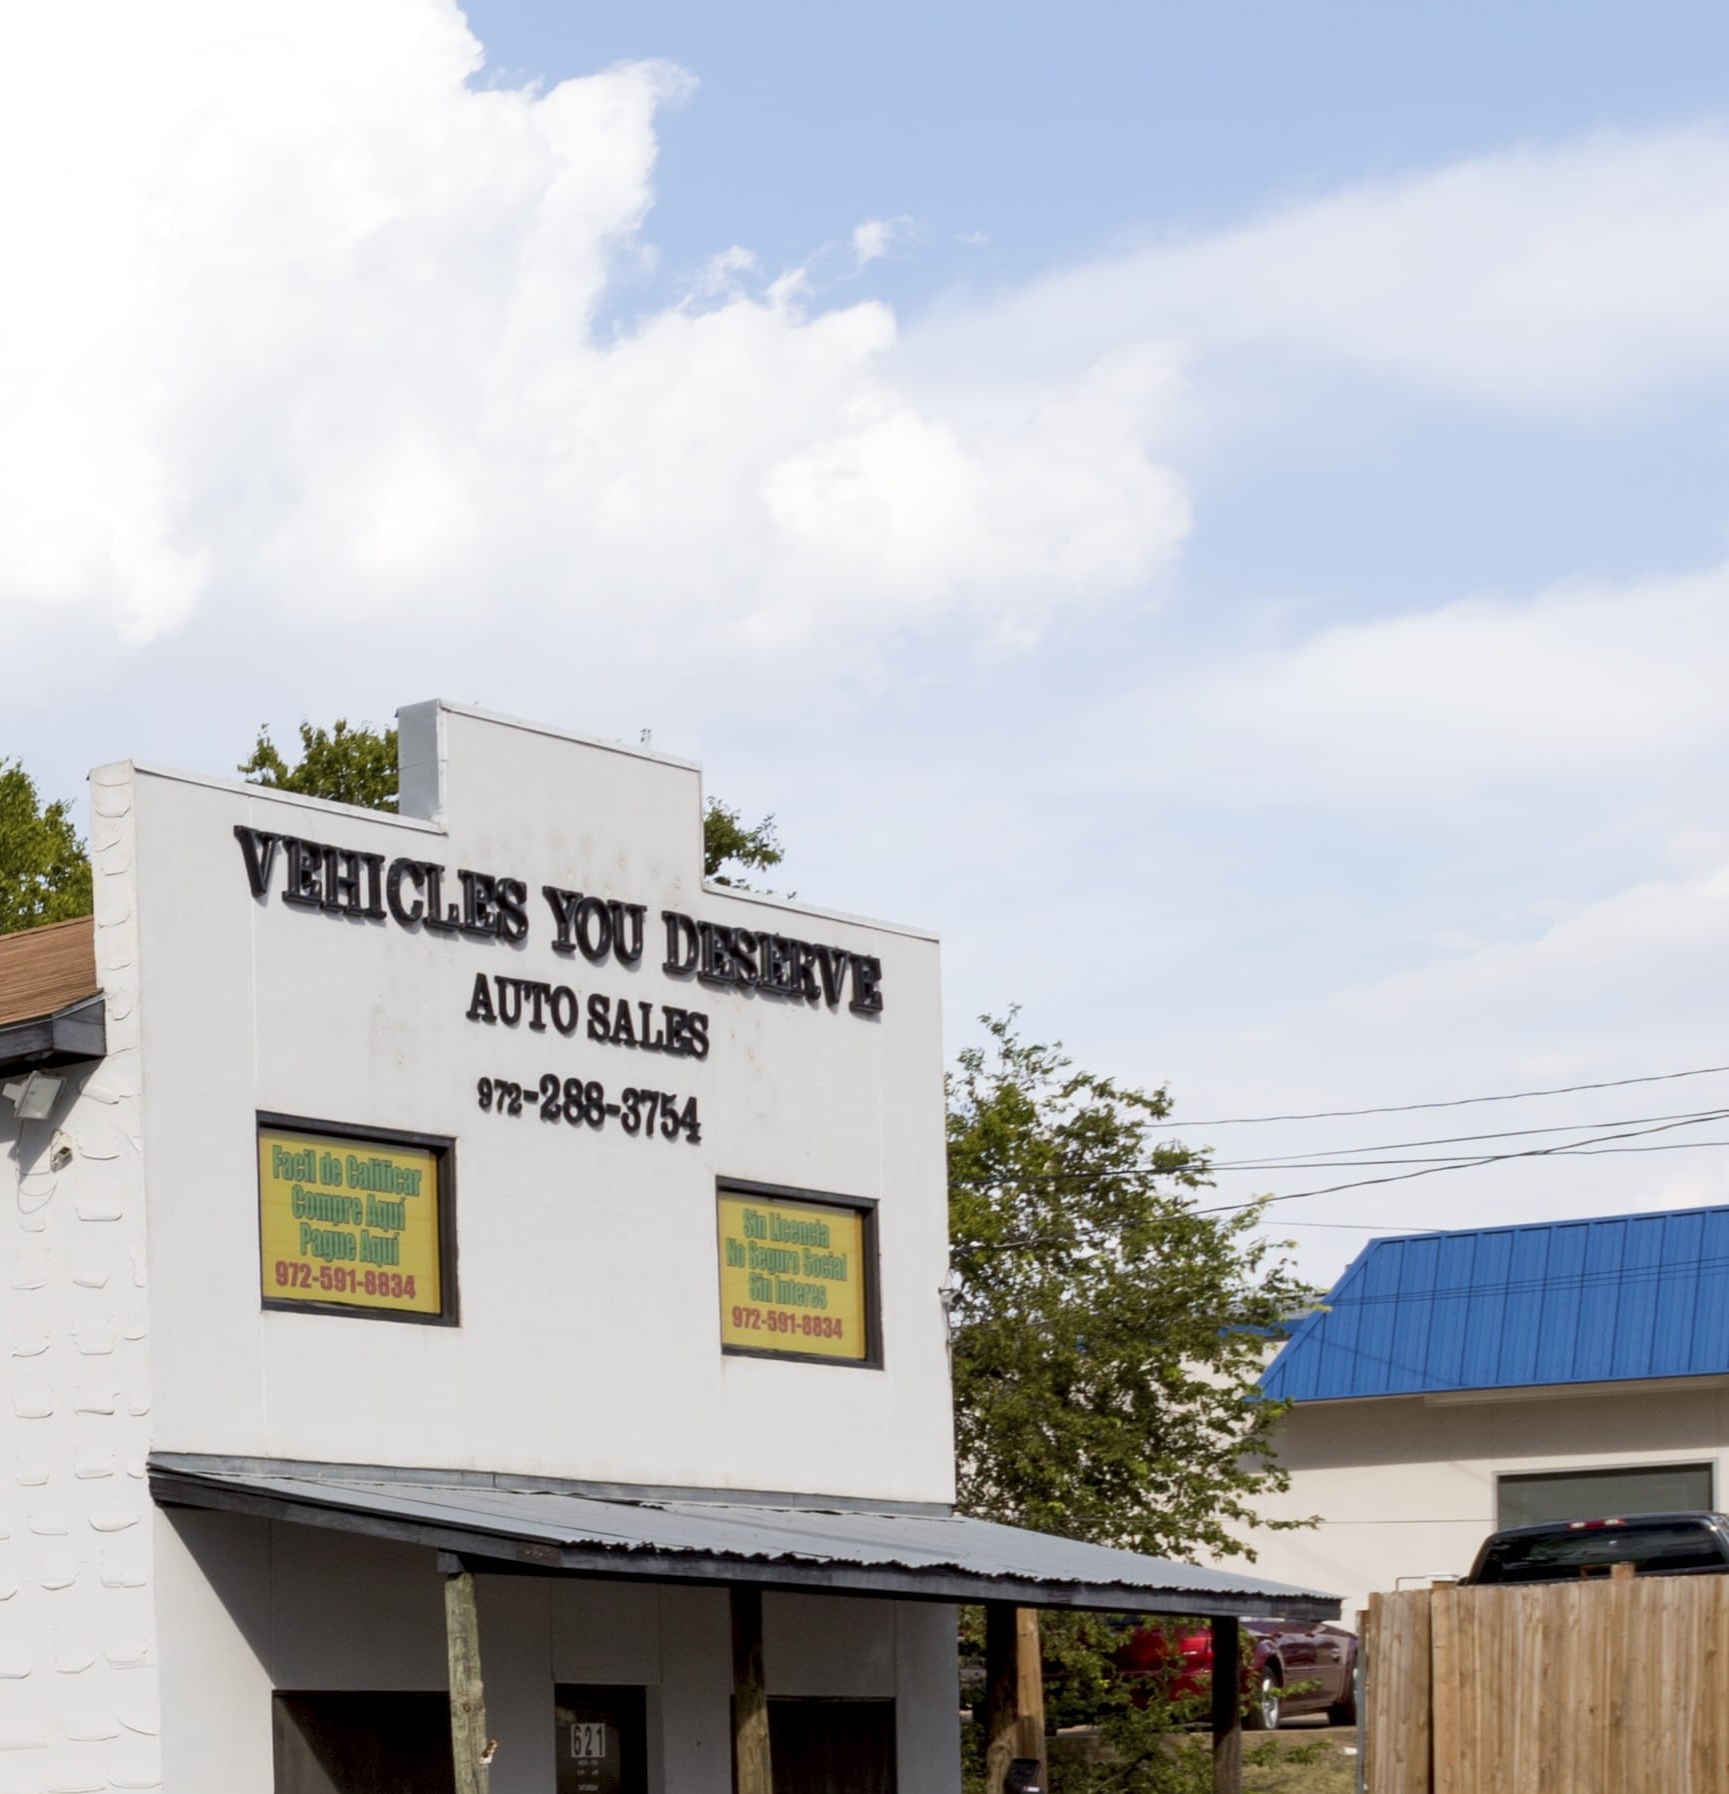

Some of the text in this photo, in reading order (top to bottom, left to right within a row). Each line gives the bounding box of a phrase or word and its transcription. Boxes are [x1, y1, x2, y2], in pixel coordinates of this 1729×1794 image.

[234, 825, 883, 1013] VEHICLES YOU DESERVE
[466, 972, 710, 1059] AUTO SALES
[477, 1073, 701, 1143] 972-288-3754
[272, 1144, 422, 1197] Facil de Calificar
[291, 1184, 362, 1226] Compre
[300, 1222, 356, 1263] Pague
[743, 1209, 830, 1249] Sin Licencia
[726, 1237, 847, 1282] No Seguro Social
[275, 1261, 416, 1300] 972-591-8834
[749, 1271, 773, 1303] Sin
[732, 1306, 843, 1339] 972-591-8834
[573, 1725, 603, 1756] 621
